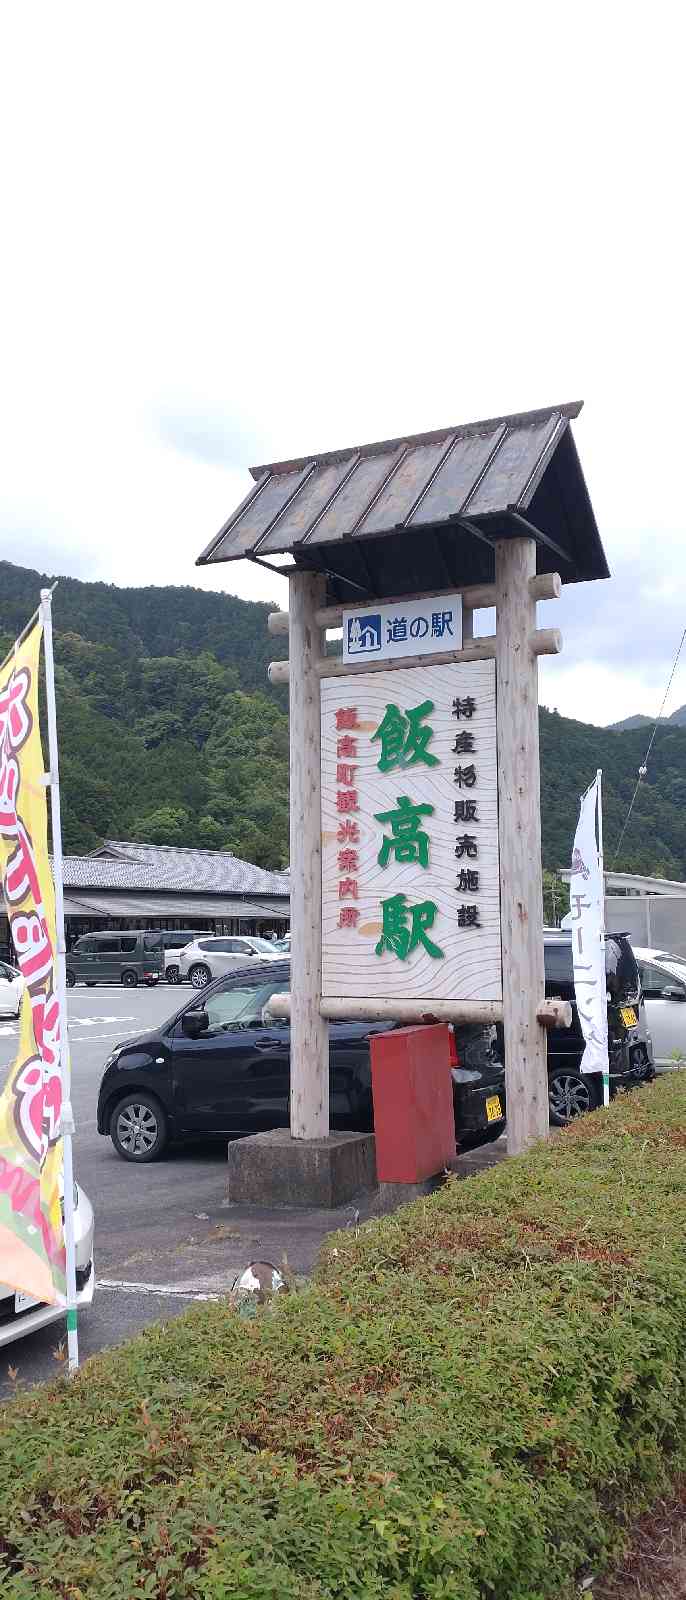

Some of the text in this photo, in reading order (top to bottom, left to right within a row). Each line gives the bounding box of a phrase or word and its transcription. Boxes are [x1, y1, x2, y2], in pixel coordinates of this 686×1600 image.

[386, 611, 453, 644] 道の駅
[334, 707, 361, 929] 飯高町観光案内所
[370, 699, 445, 961] 飯高駅
[451, 696, 481, 929] 特産物販売施設
